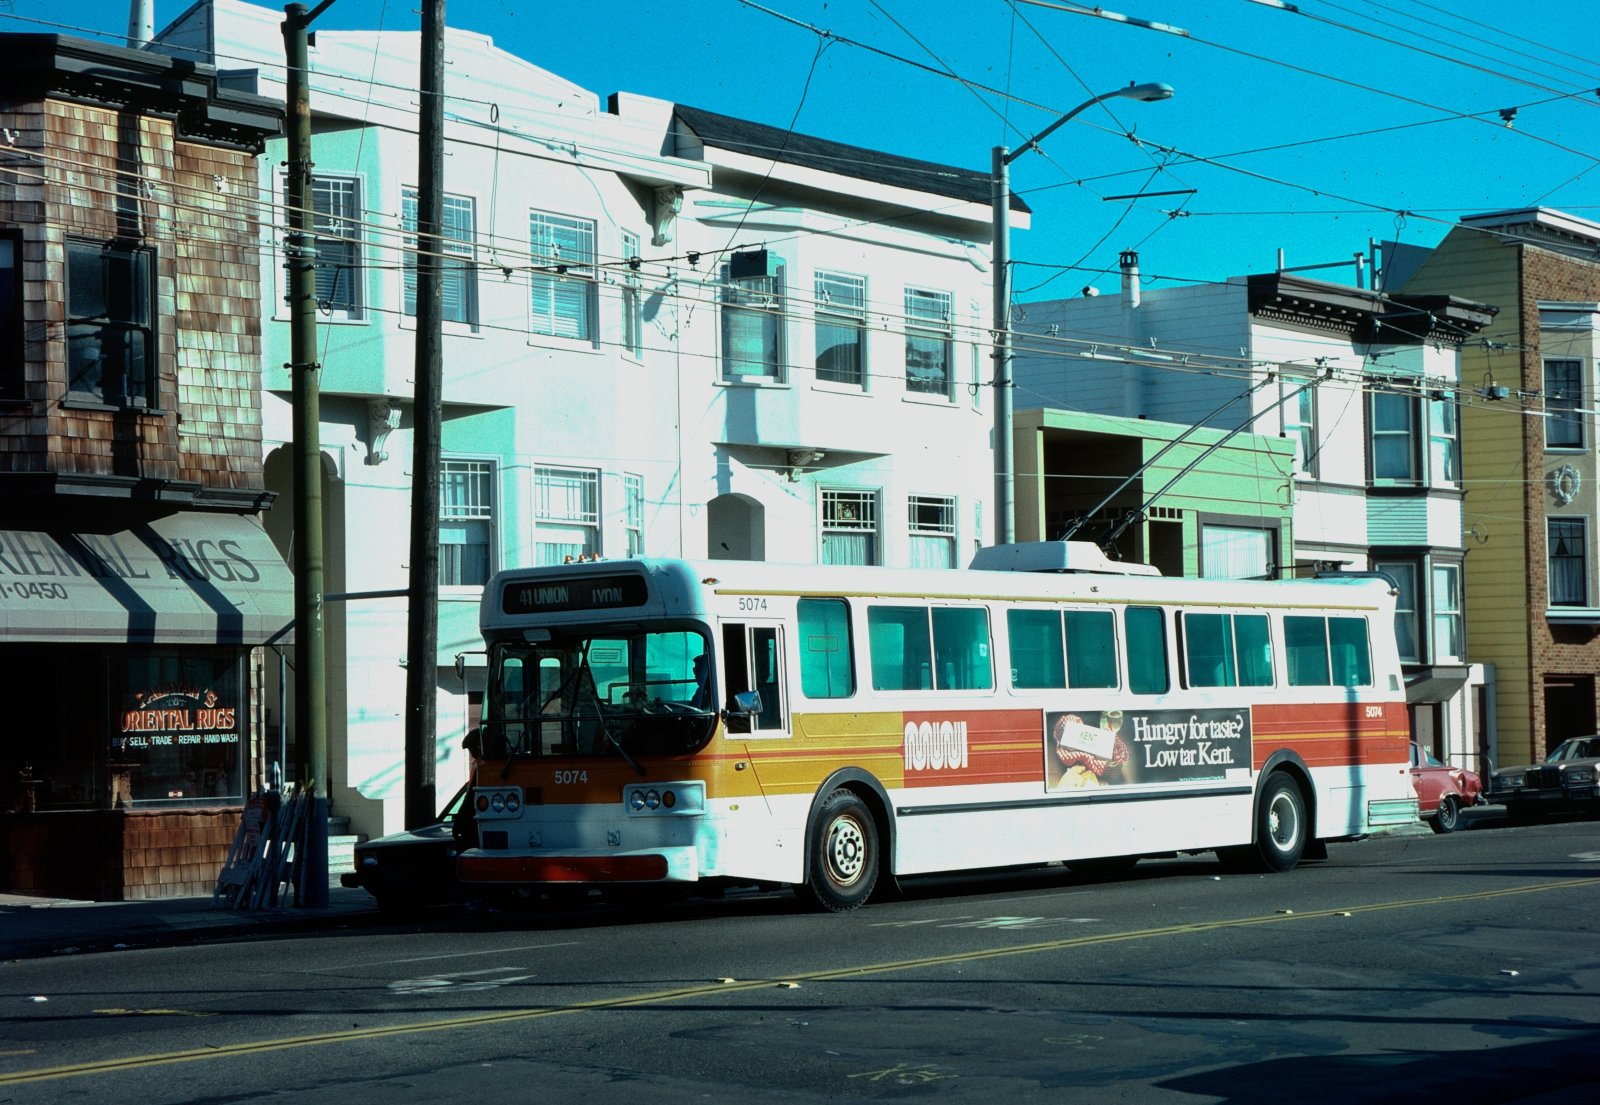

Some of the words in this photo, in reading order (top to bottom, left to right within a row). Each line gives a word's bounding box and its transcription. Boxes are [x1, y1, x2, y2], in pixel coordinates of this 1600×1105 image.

[153, 537, 261, 583] RUGS
[520, 588, 532, 606] 41
[533, 586, 569, 604] UNION
[738, 597, 767, 611] 5074
[121, 710, 195, 732] ORIENTAL
[196, 708, 235, 730] RUGS
[1365, 705, 1383, 718] 5074
[1132, 716, 1186, 744] Hungry
[1189, 714, 1208, 740] for
[1209, 714, 1244, 739] taste?
[129, 736, 149, 746] SELL
[151, 735, 173, 745] TRADE
[178, 734, 201, 744] REPAIR
[204, 733, 220, 743] HAND
[220, 733, 238, 743] WASH
[1144, 744, 1179, 768] Low
[1179, 746, 1197, 765] tar
[1197, 741, 1235, 765] Kent.
[554, 770, 588, 784] 5074
